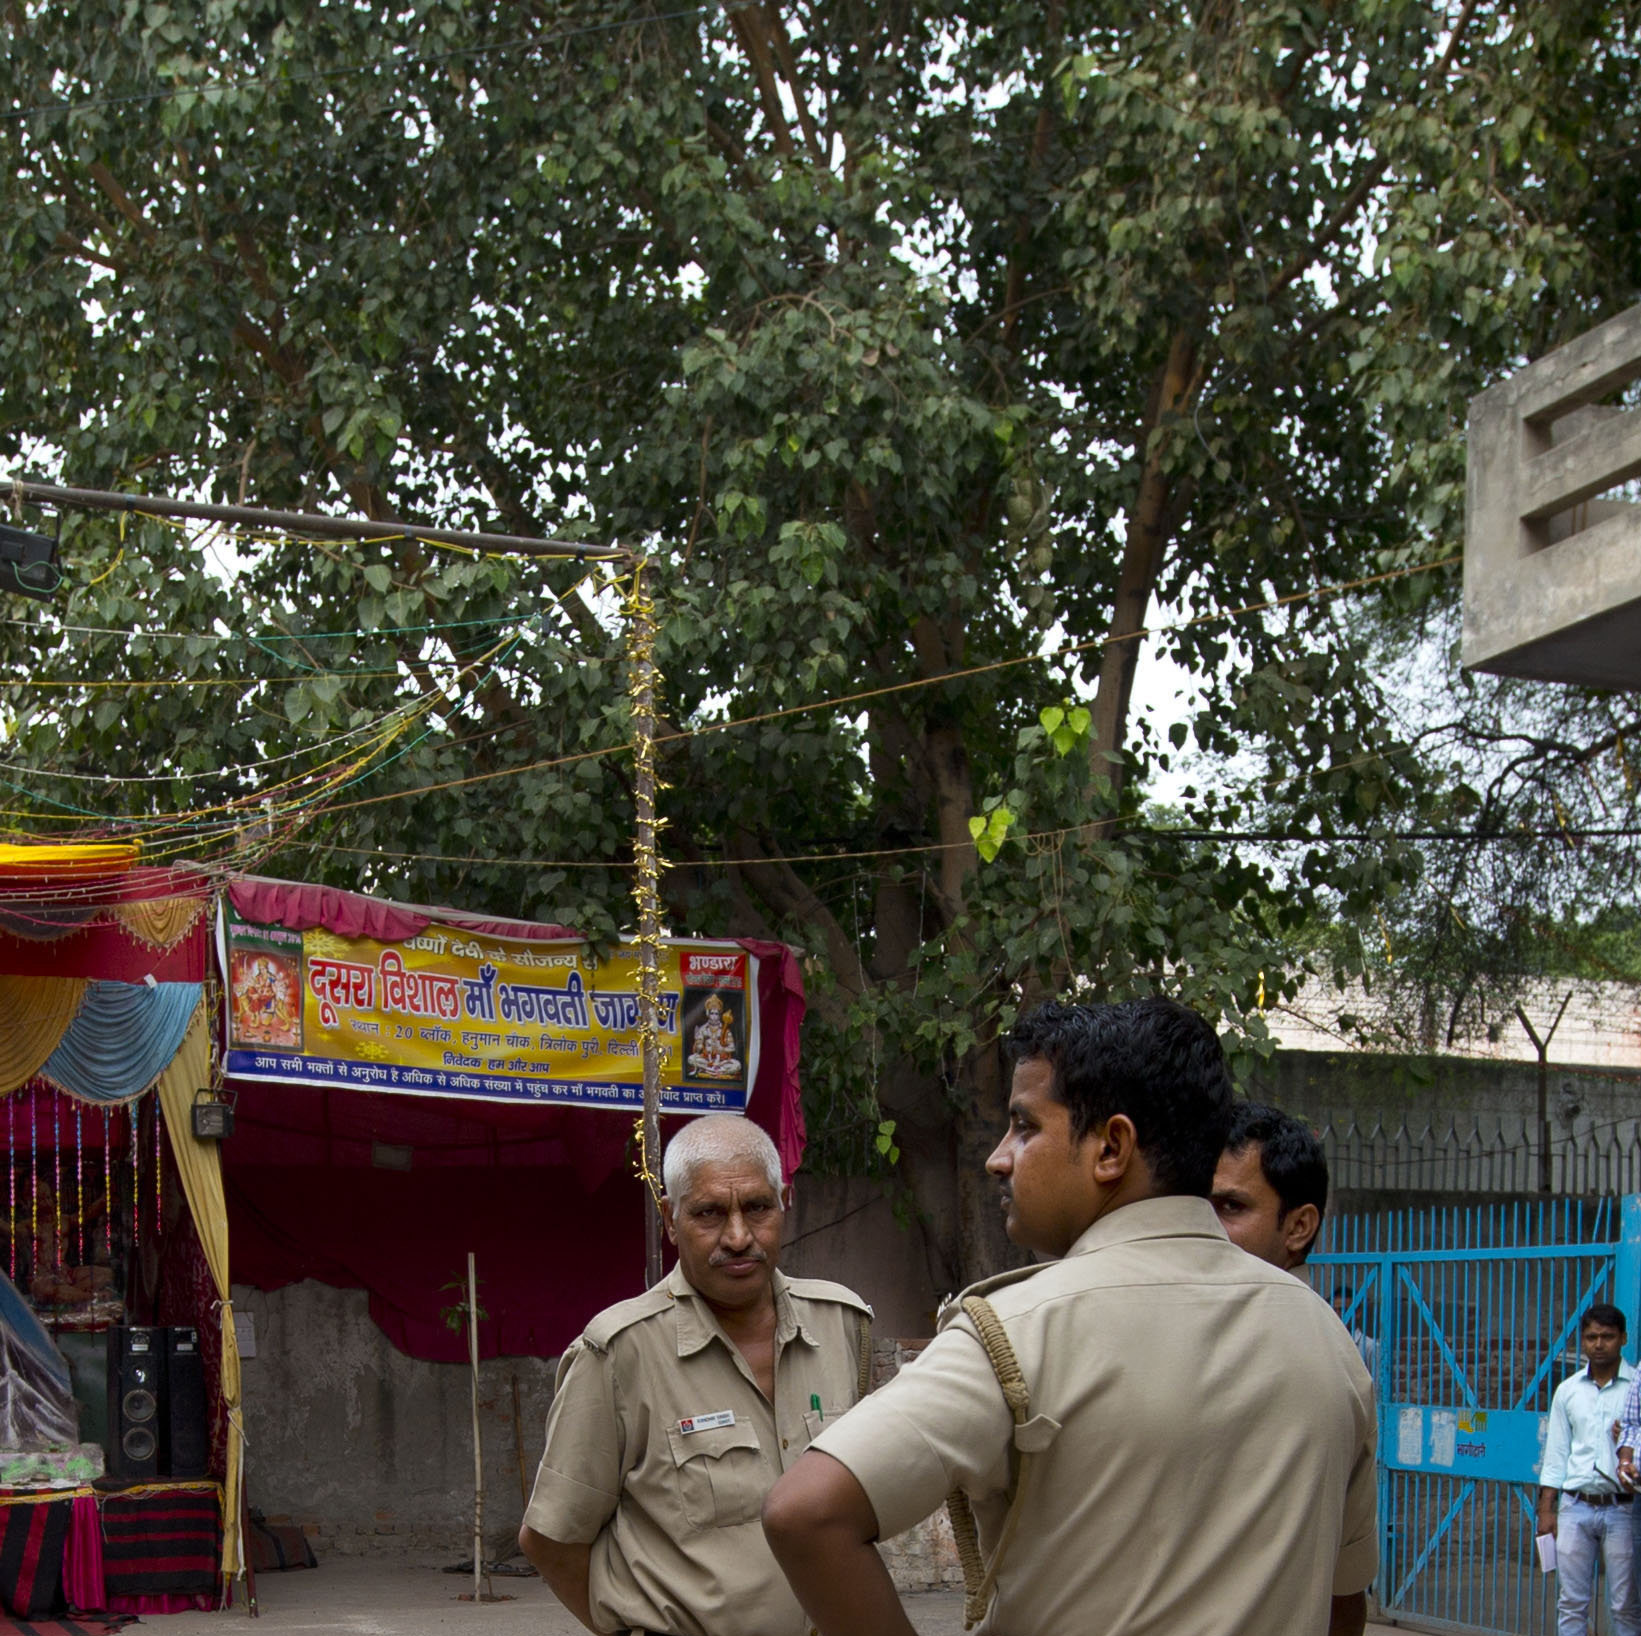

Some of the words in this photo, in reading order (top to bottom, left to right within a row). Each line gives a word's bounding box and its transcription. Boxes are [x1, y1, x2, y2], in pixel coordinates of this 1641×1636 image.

[451, 939, 484, 960] देवी
[511, 948, 578, 969] सौजन्य
[689, 955, 739, 971] भण्डारा
[309, 957, 374, 1027] दूसरा
[380, 949, 459, 1018] विशाल
[463, 963, 498, 1021] माँ
[500, 971, 589, 1028] भगवती
[589, 992, 680, 1033] जागण
[395, 1025, 413, 1039] 20
[461, 1031, 501, 1050] हनुमान
[540, 1034, 577, 1052] त्रिलोक
[607, 1039, 639, 1057] दिल्ली
[443, 1050, 482, 1068] निवेदक
[488, 1058, 505, 1071] हम
[508, 1057, 528, 1072] और
[529, 1061, 550, 1073] आप
[255, 1056, 276, 1069] आप
[280, 1056, 302, 1072] सभी
[306, 1060, 334, 1075] भक्तों
[337, 1062, 348, 1076] से
[351, 1065, 387, 1083] अनुरोध
[391, 1066, 398, 1083] है
[402, 1069, 432, 1084] अधिक
[436, 1072, 446, 1086] से
[450, 1073, 481, 1089] अधिक
[483, 1077, 511, 1092] संख्या
[514, 1079, 523, 1093] में
[552, 1084, 568, 1096] कर
[571, 1083, 583, 1096] माँ
[586, 1084, 619, 1099] भगवती
[622, 1089, 635, 1100] का
[683, 1091, 703, 1104] प्राप्त
